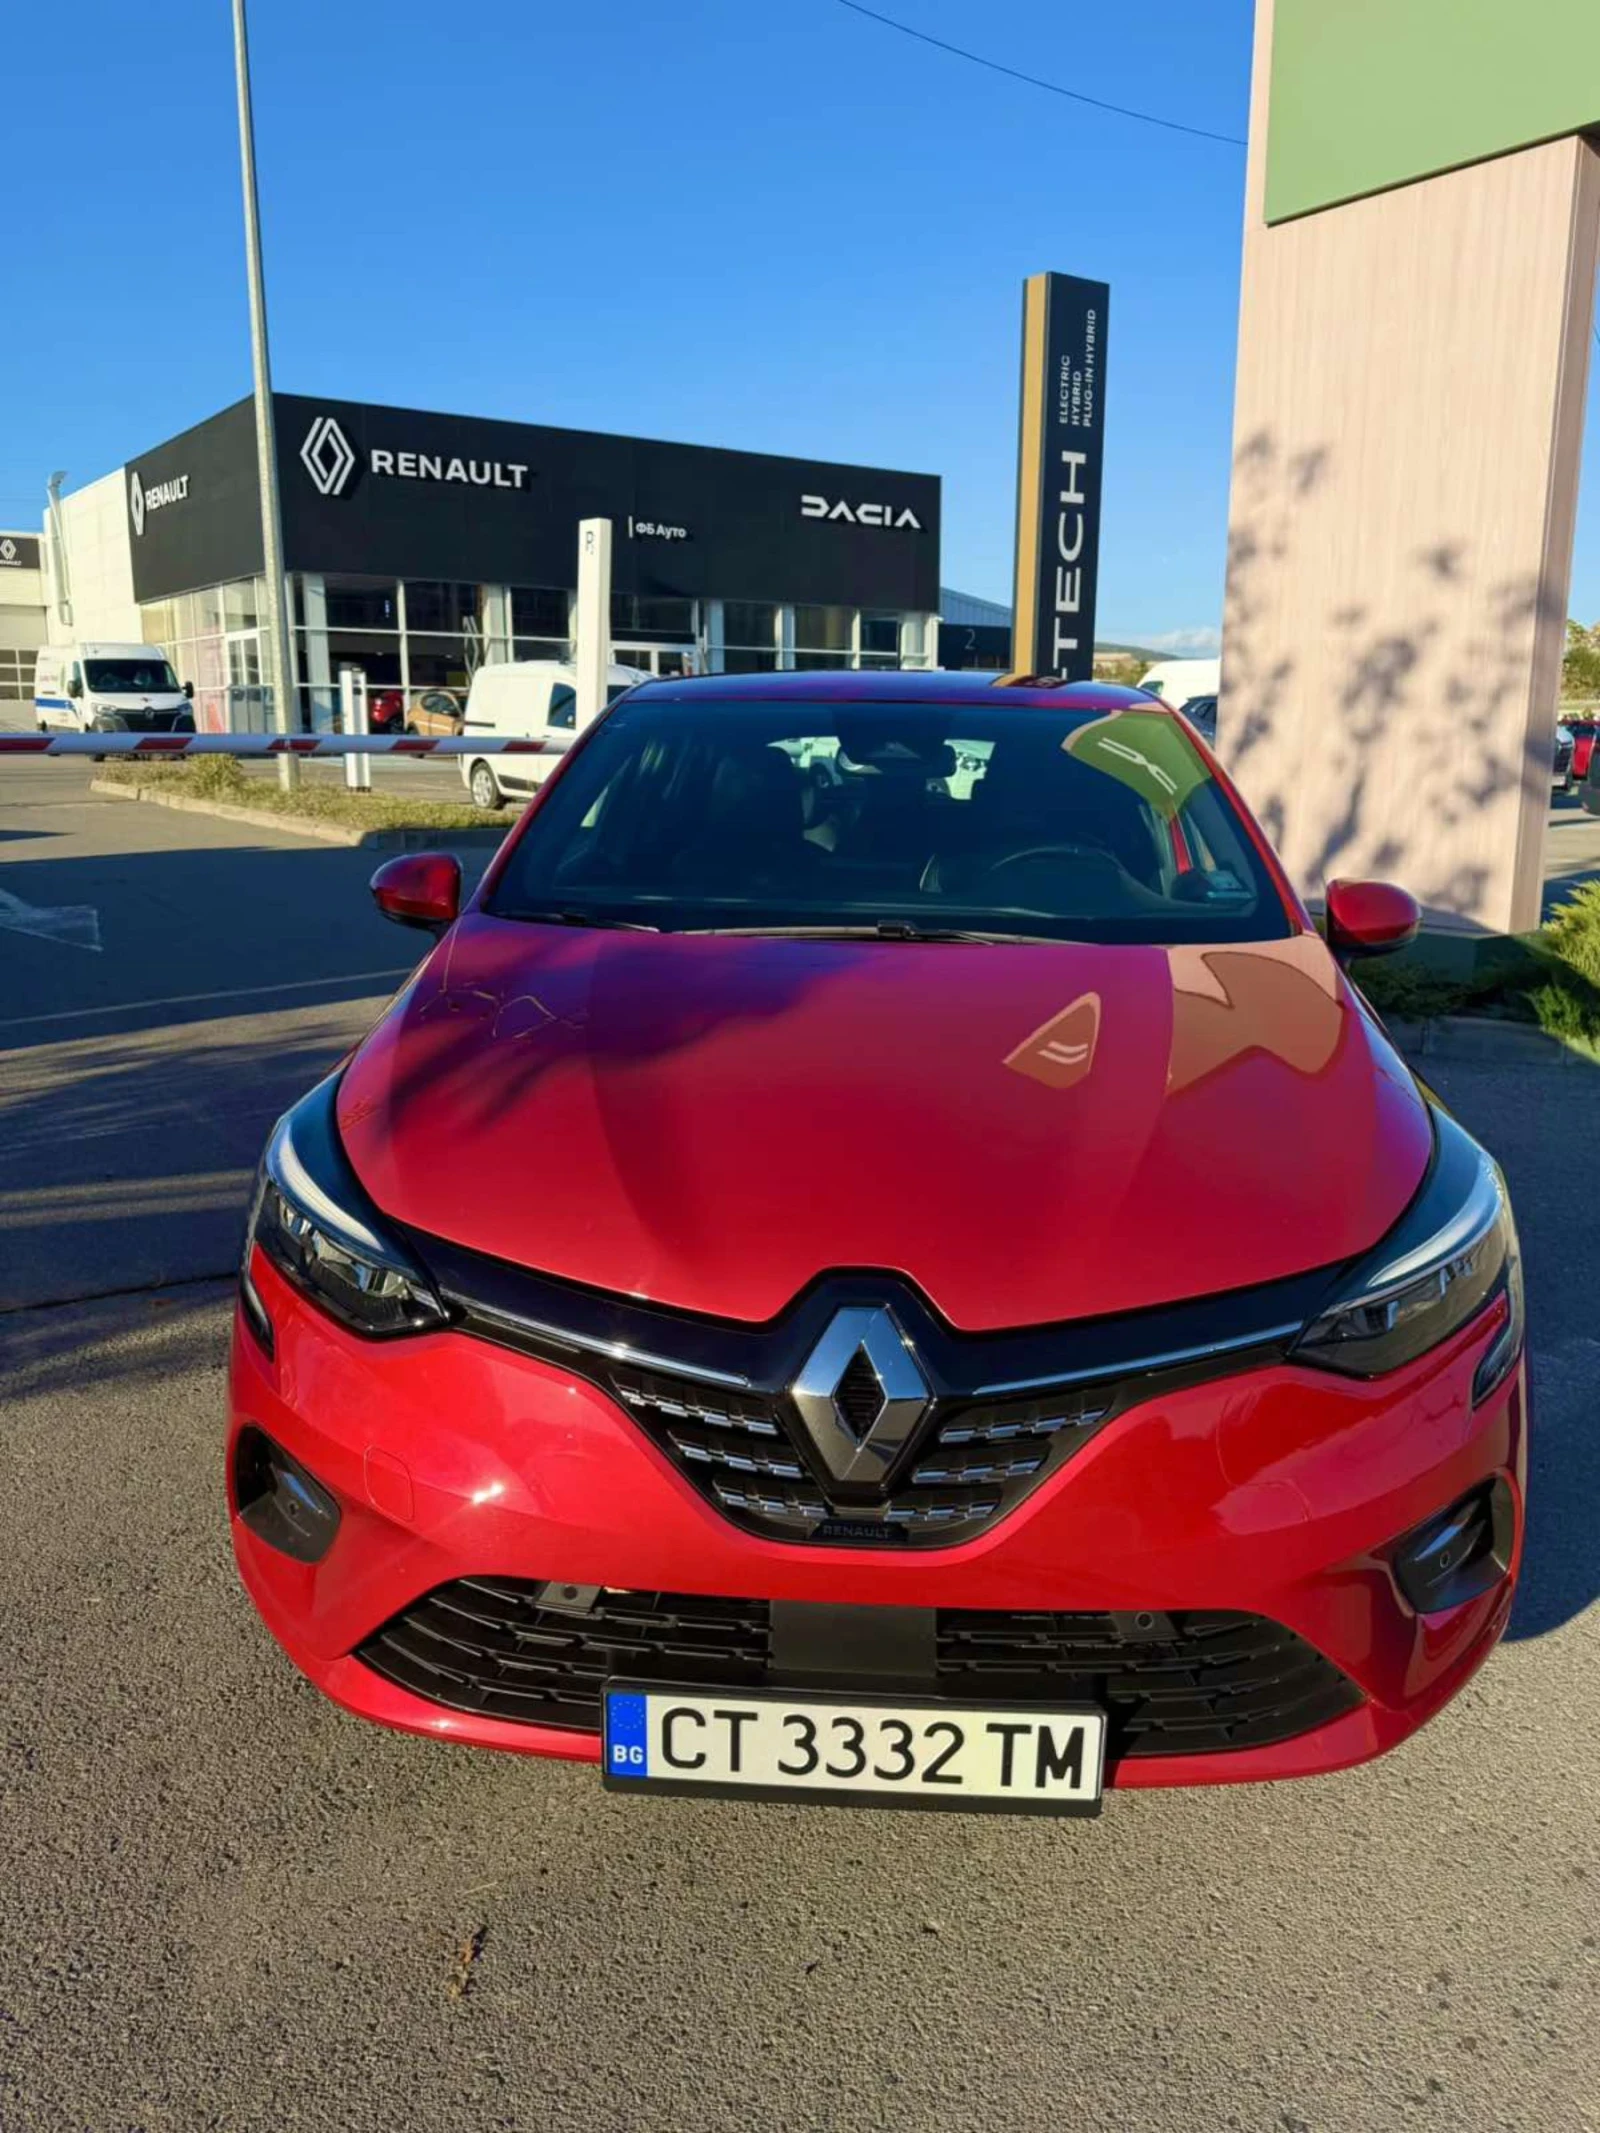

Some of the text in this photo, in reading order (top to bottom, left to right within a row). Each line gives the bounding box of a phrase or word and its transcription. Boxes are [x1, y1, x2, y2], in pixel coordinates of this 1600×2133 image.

[1082, 308, 1097, 428] PLUG-IN HYBRID
[1059, 354, 1070, 424] ELECTRIC
[1071, 370, 1082, 426] HYBRID
[371, 449, 528, 488] RENAULT
[145, 474, 188, 512] RENAULT
[801, 494, 921, 529] DACIA
[635, 522, 687, 540] ФБ Ауто
[964, 628, 976, 650] 2
[823, 1524, 889, 1539] RENAULT
[612, 1743, 644, 1765] BG
[661, 1707, 1085, 1789] CT 3332 TM
